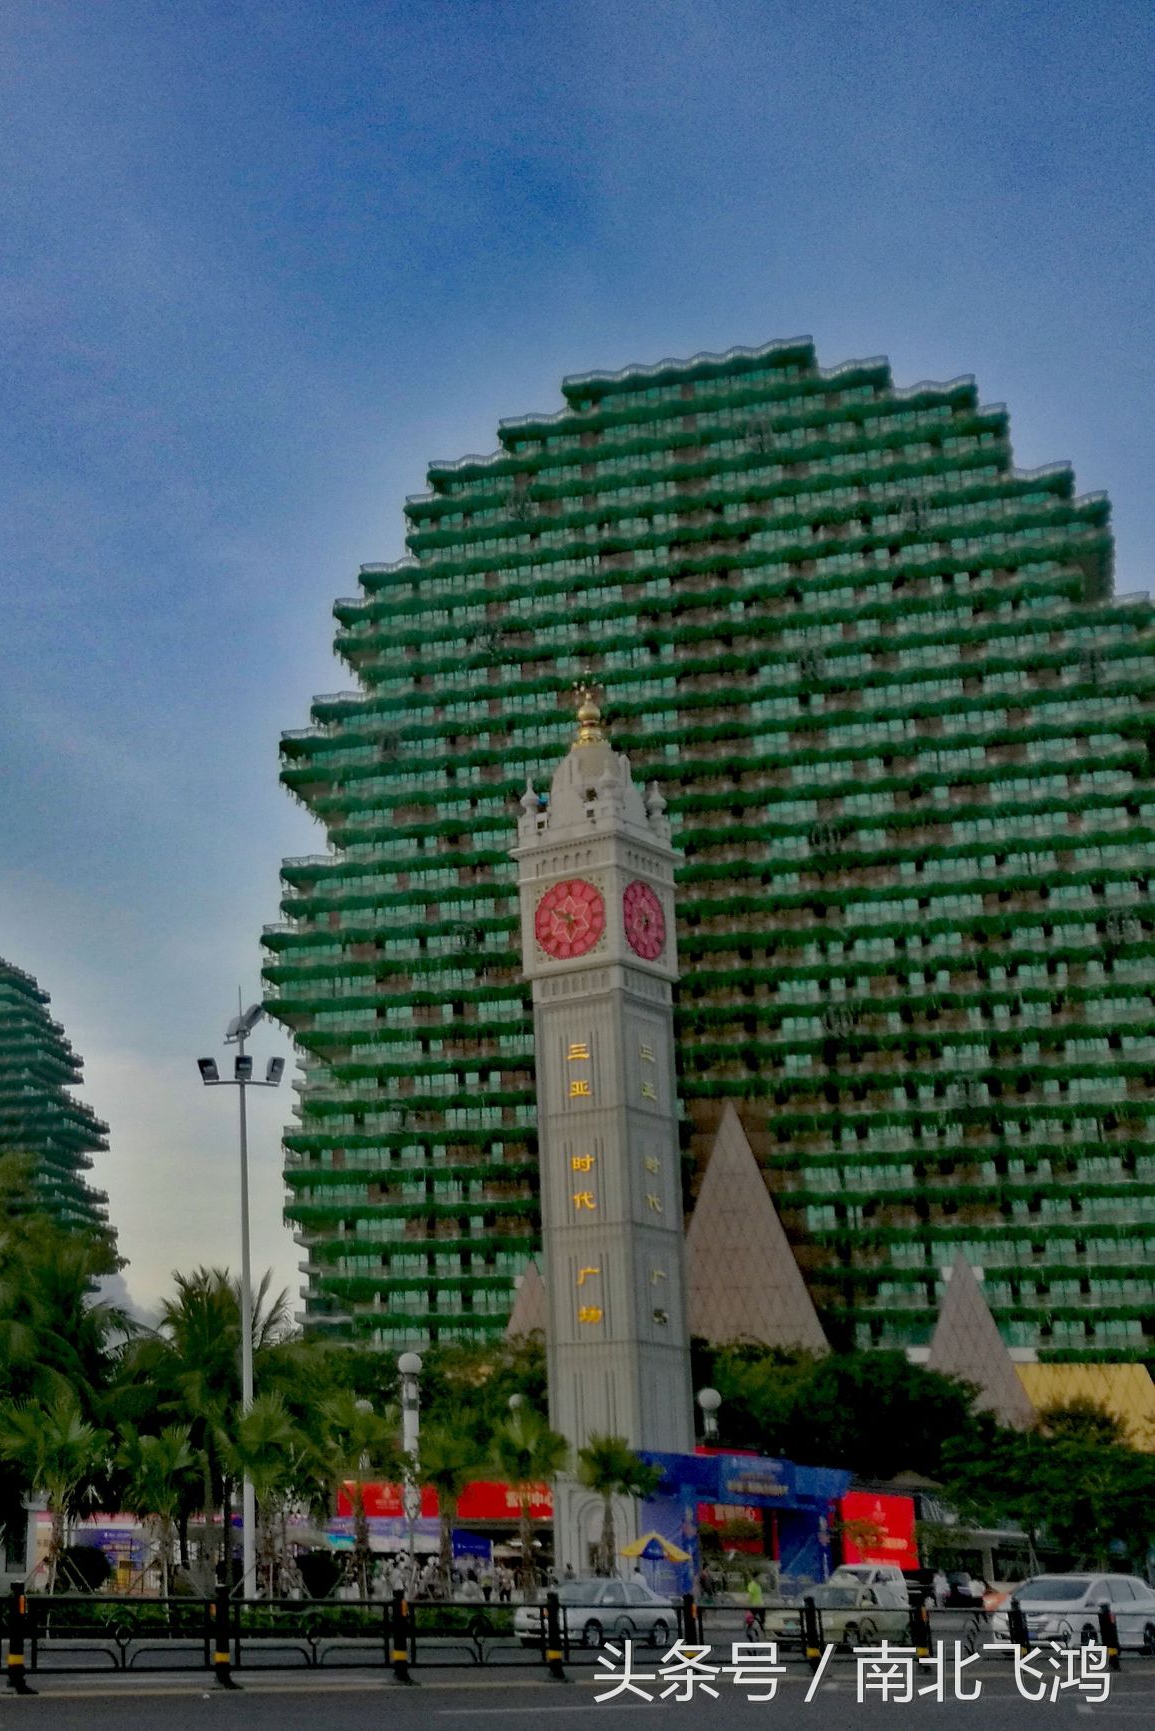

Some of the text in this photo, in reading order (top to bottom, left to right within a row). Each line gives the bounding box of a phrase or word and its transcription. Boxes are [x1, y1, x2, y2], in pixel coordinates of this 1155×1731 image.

[566, 1043, 603, 1324] 三亚时代广场
